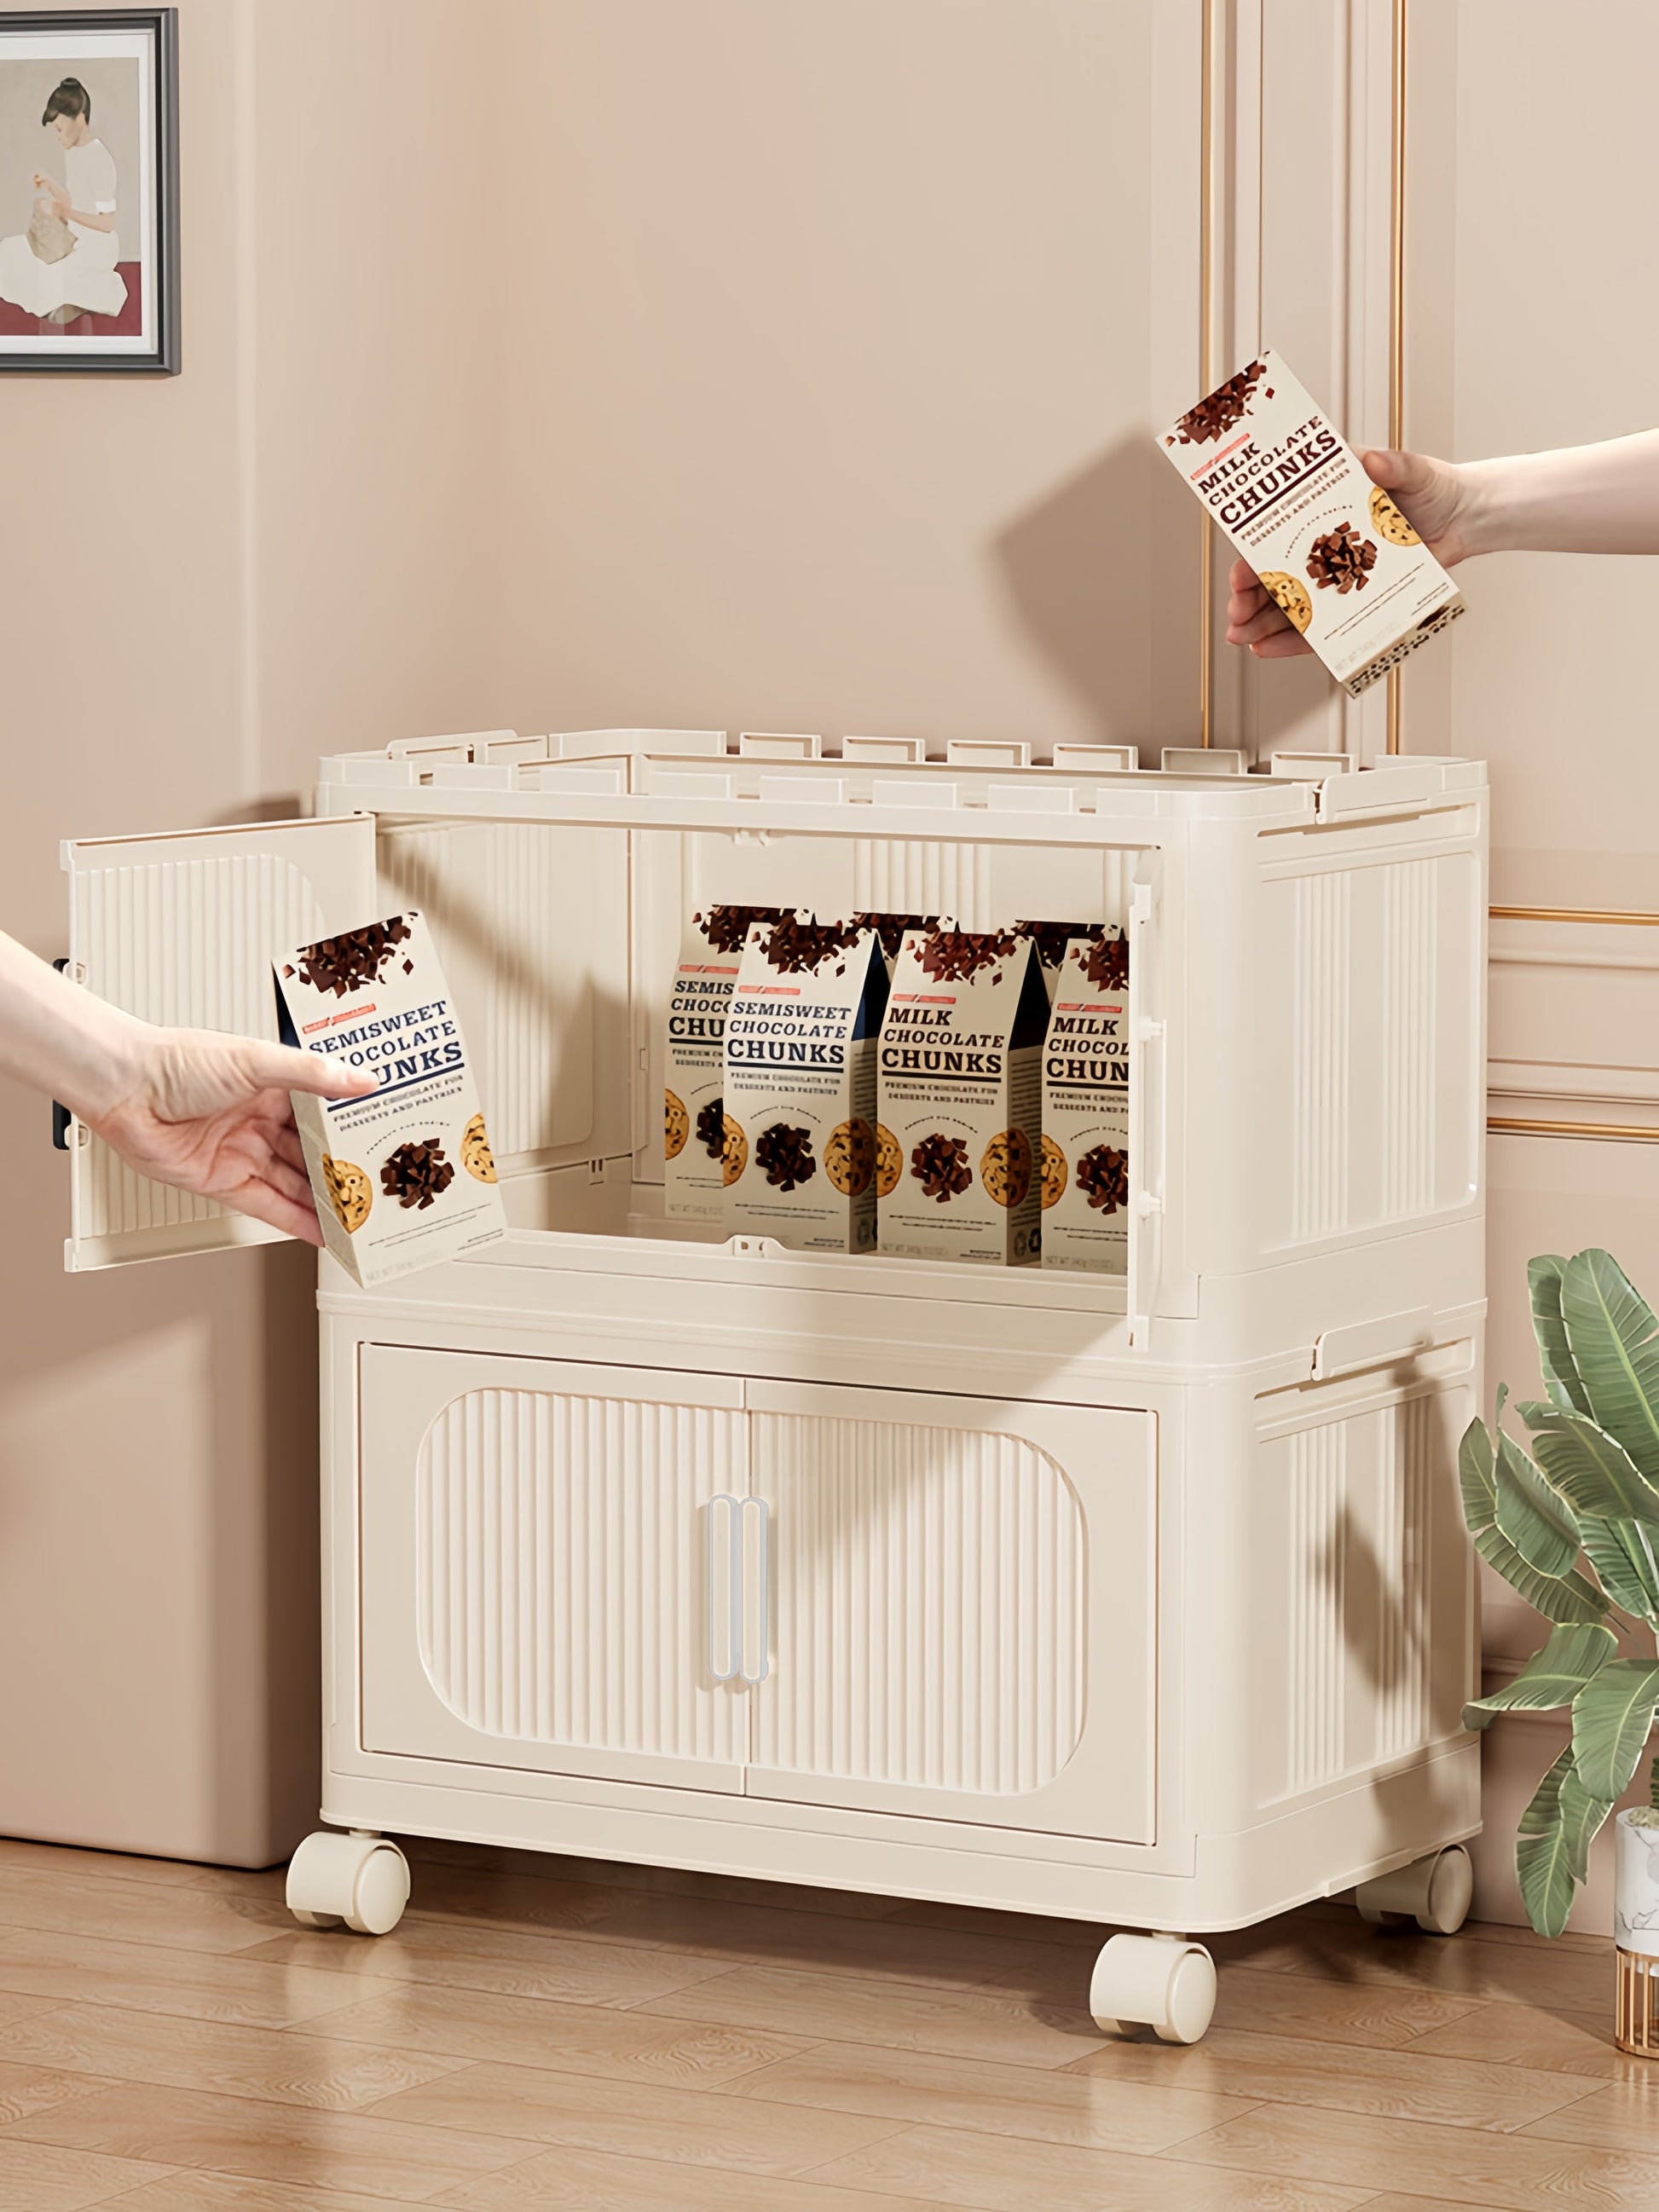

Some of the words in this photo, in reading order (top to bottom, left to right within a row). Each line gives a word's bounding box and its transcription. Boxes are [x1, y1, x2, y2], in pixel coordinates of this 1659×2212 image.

[1198, 442, 1261, 494] MILK
[1209, 415, 1322, 506] CHOCOLATE
[1220, 429, 1336, 524] CHUNKS
[674, 980, 734, 996] SEMIS
[733, 1002, 852, 1020] SEMISWEET
[888, 1008, 953, 1026] MILK
[309, 1000, 447, 1054] SEMISWEET
[668, 1016, 725, 1037] CHU
[730, 1020, 847, 1039] CHOCOLATE
[884, 1028, 1005, 1048] CHOCOLATE
[1053, 1017, 1119, 1036] MILK
[339, 1020, 456, 1066] OCOLATE
[727, 1038, 844, 1065] CHUNKS
[1049, 1038, 1129, 1055] CHOCOL
[371, 1041, 462, 1085] UNKS
[882, 1048, 1002, 1074] CHUNKS
[1047, 1058, 1128, 1082] CHUN
